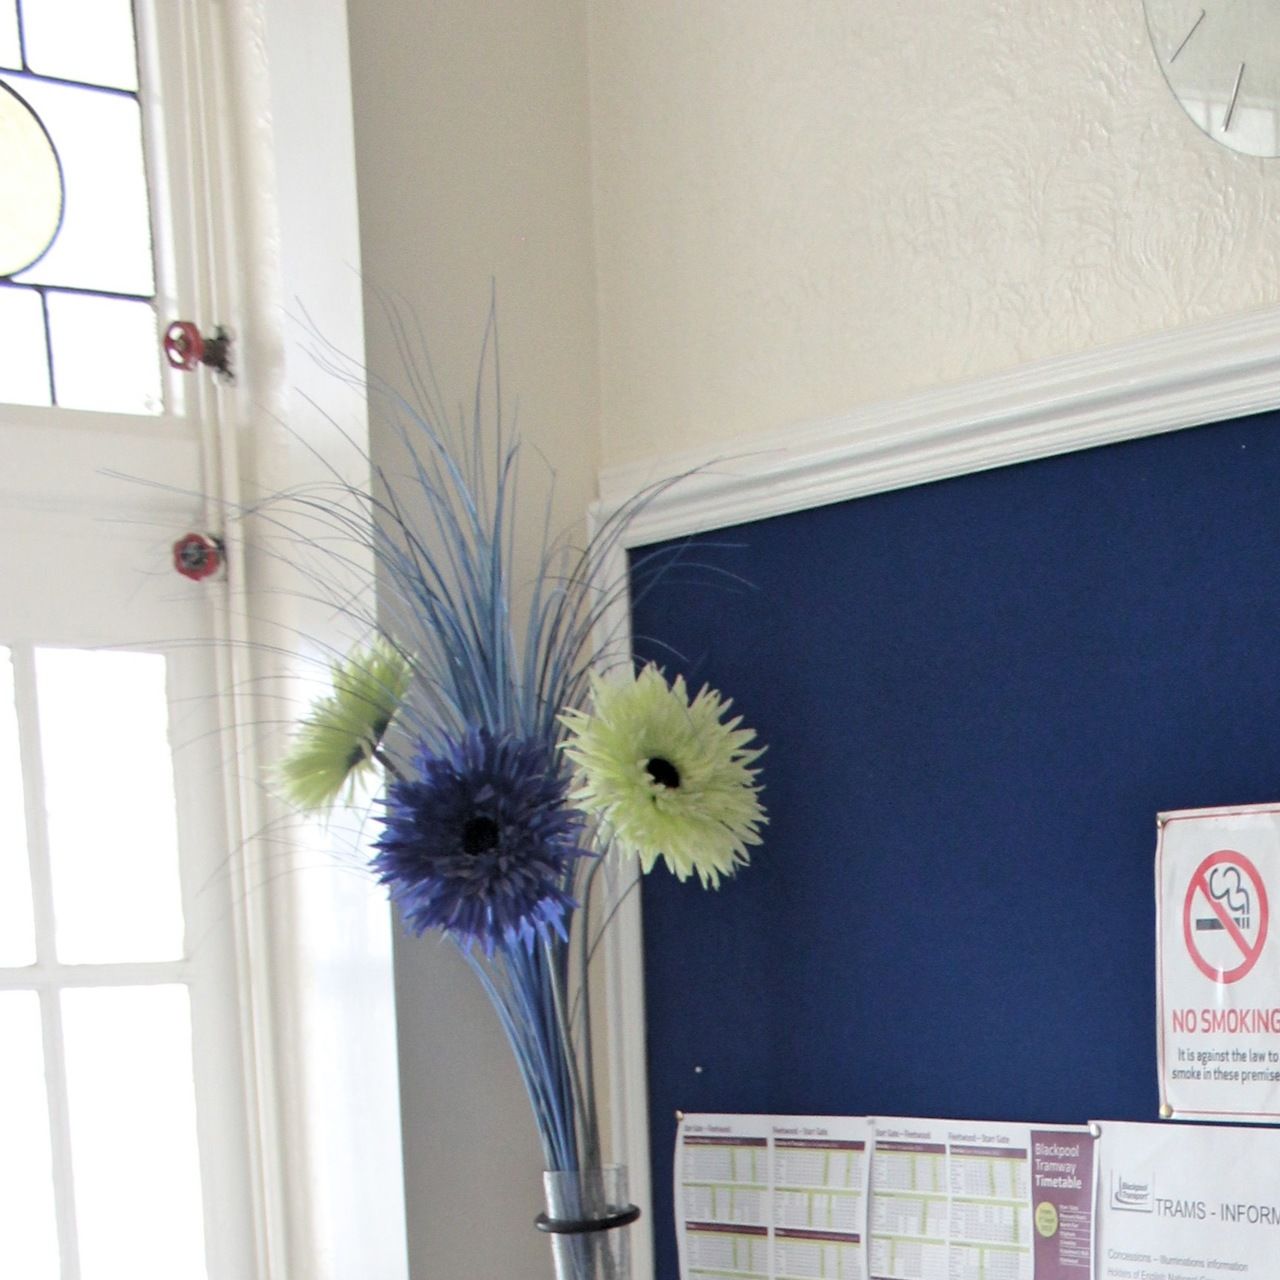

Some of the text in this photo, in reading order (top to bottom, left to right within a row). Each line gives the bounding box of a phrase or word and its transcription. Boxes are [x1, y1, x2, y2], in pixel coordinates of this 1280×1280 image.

[1173, 1009, 1197, 1033] NO
[1178, 1049, 1279, 1065] It is against the law to
[1172, 1068, 1201, 1080] smoke
[1204, 1068, 1212, 1080] in
[1214, 1067, 1240, 1081] these
[1035, 1143, 1079, 1158] Blackpool
[1035, 1159, 1076, 1174] Tramway
[1035, 1174, 1082, 1189] Timetable
[1156, 1198, 1206, 1219] TRAMS
